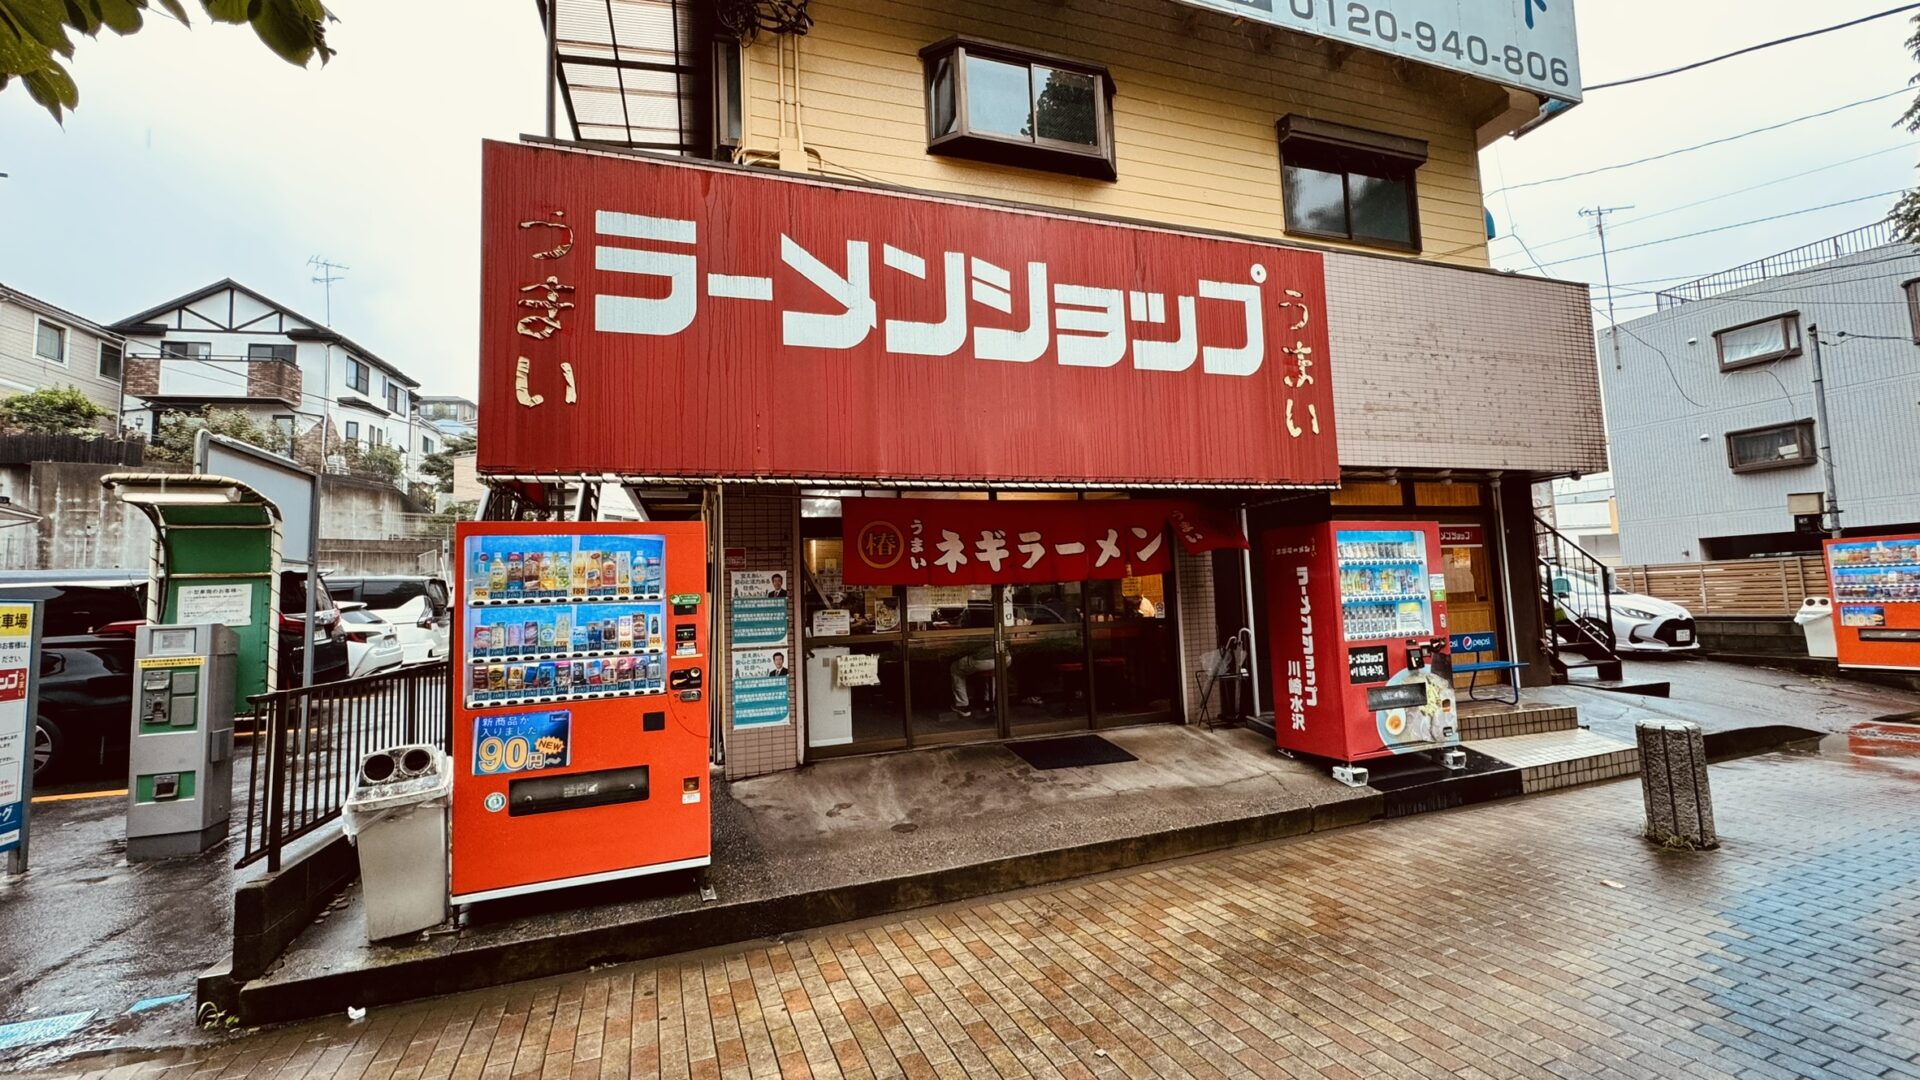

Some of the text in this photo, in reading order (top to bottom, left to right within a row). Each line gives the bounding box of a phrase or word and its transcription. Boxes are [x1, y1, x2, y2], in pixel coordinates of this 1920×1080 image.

[1289, 0, 1569, 87] 0120-940-806
[516, 210, 577, 408] うまい
[594, 209, 1267, 377] ラーメンショップ
[1278, 288, 1320, 437] うまい
[910, 519, 927, 570] うまい
[933, 527, 1162, 574] ネギラーメン
[0, 613, 28, 630] 車場
[0, 640, 29, 650] お客様は、
[1296, 566, 1318, 707] ラーメンショップ
[1472, 636, 1491, 648] pepsi
[480, 727, 537, 738] 入りました
[481, 716, 529, 728] 新商品が
[538, 739, 562, 752] NEW
